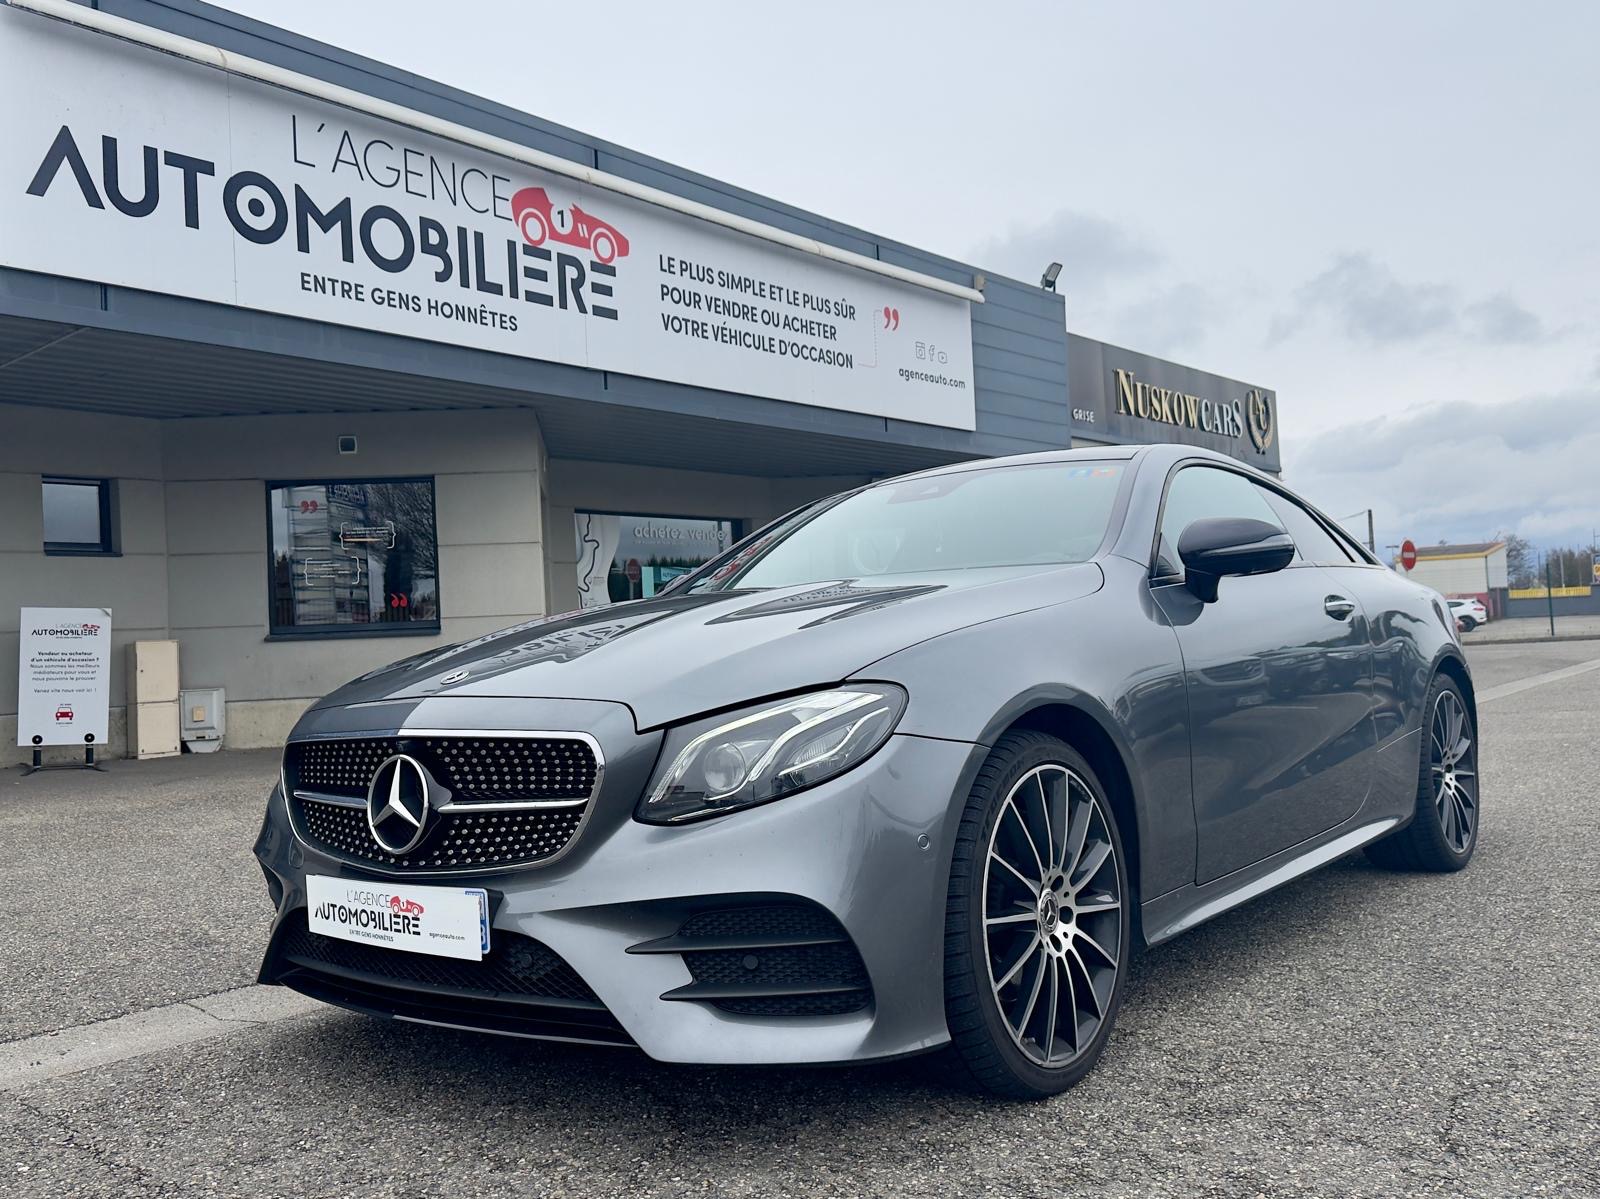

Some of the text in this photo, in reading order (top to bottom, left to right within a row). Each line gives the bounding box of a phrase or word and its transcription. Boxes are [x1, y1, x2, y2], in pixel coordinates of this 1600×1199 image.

[292, 114, 513, 221] L'AGENCE
[25, 125, 619, 321] AUTOMOBILIERE
[300, 272, 519, 332] ENTRE GENS HONNÊTES
[659, 254, 856, 321] LE PLUS SIMPLE ET LE PLUS SÛR
[660, 283, 838, 341] POUR VENDRE OU ACHETER
[661, 312, 854, 370] VOTRE VÉHICULE D'OCCASION
[898, 368, 966, 389] agenceauto.com
[1072, 408, 1095, 423] GRISE
[633, 521, 684, 539] achetez
[31, 628, 98, 636] AUTOMOBILIERE
[346, 889, 392, 909] L'AGENCE
[314, 901, 421, 936] AUTOMOBILIERE
[428, 932, 466, 942] agenceauto.com
